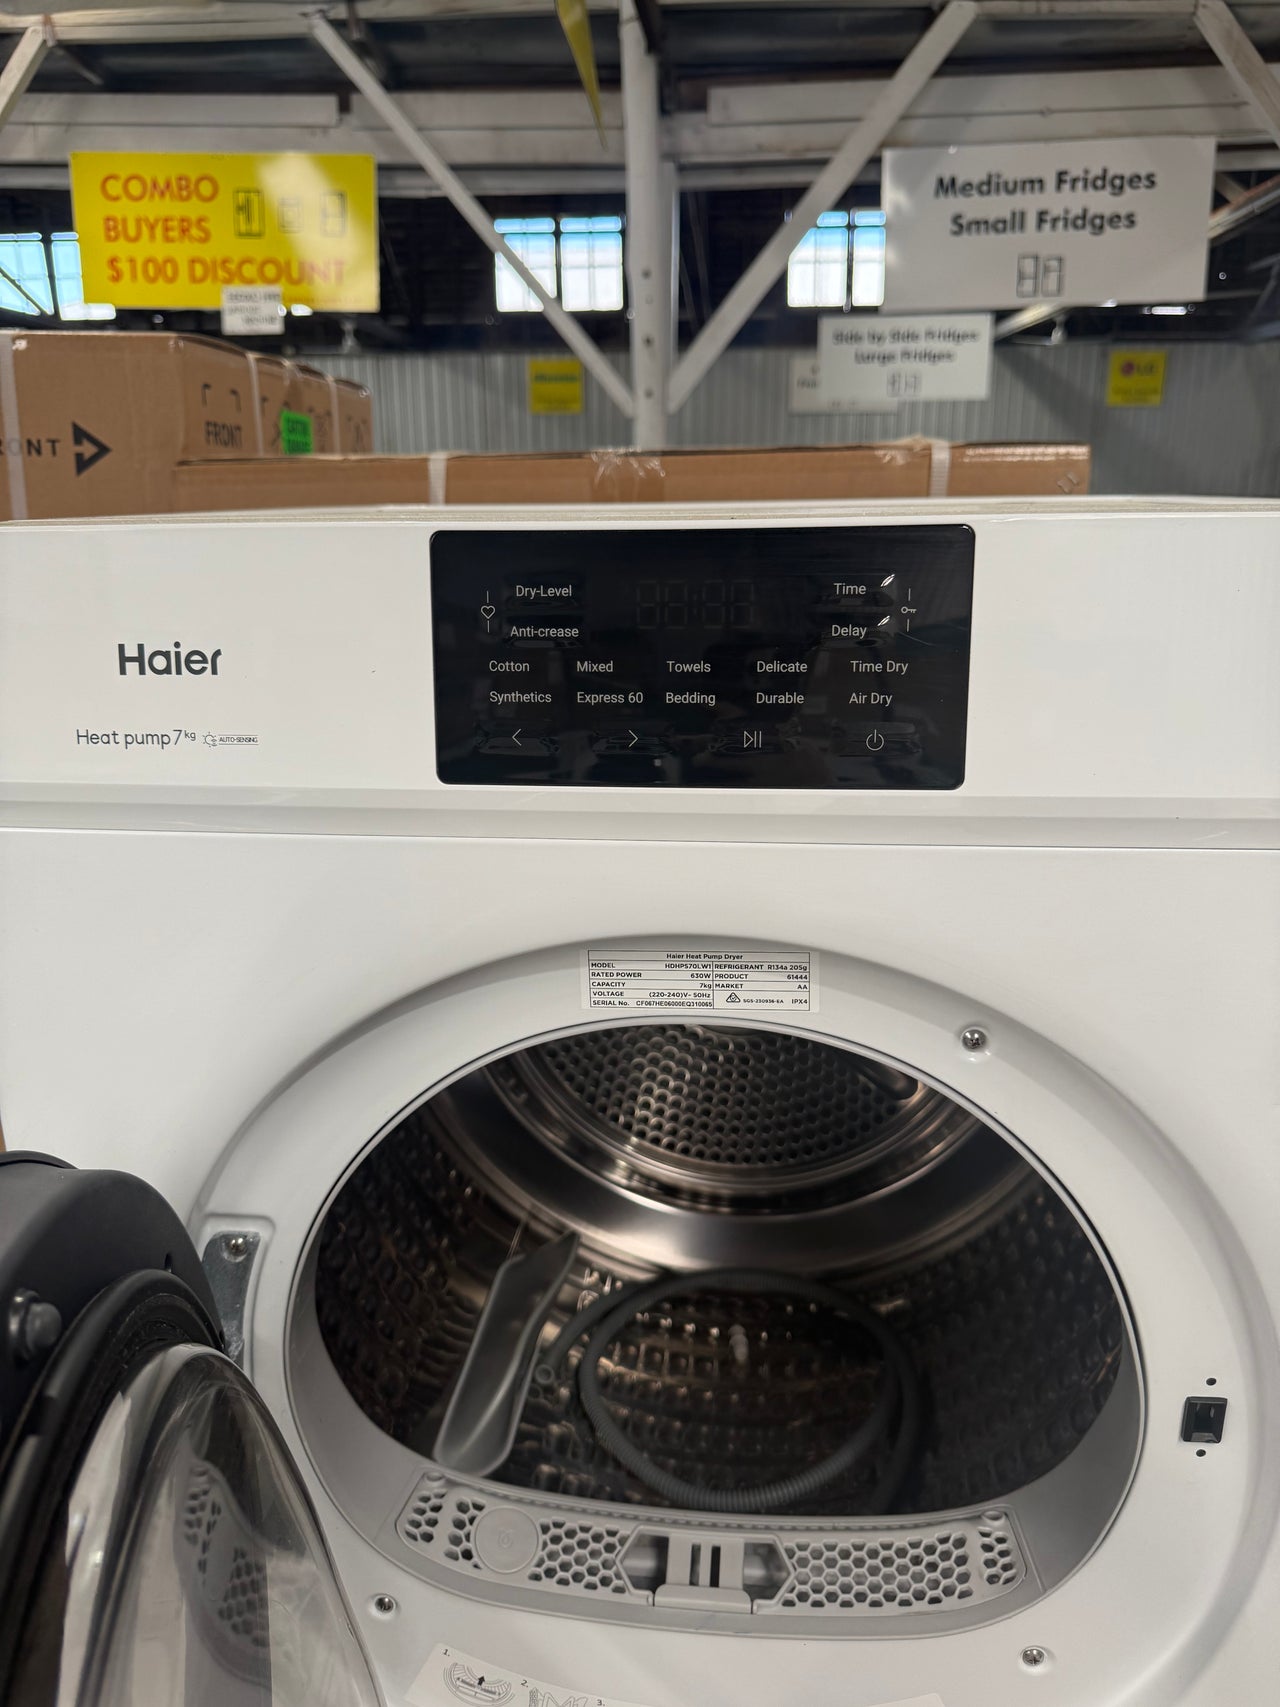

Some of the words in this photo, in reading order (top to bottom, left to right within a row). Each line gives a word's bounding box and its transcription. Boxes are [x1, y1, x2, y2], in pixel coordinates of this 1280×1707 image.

[100, 174, 220, 202] COMBO
[934, 171, 1045, 199] Medium
[1055, 167, 1157, 196] Fridges
[951, 210, 1026, 236] Small
[1036, 206, 1136, 235] Fridges
[103, 215, 211, 243] BUYERS
[107, 256, 179, 284] $100
[188, 256, 345, 285] DISCOUNT
[516, 585, 572, 599] Dry-Level
[834, 582, 867, 595] Time
[510, 626, 579, 638] Anti-crease
[831, 624, 867, 639] Delay
[117, 641, 222, 676] Haier
[489, 660, 530, 673] Cotton
[576, 660, 614, 673] Mixed
[667, 661, 711, 673] Towels
[756, 660, 808, 673] Delicate
[850, 660, 883, 673] Time
[886, 661, 909, 675] Dry
[489, 691, 552, 705] Synthetics
[576, 692, 625, 706] Express
[628, 692, 644, 704] 60
[665, 692, 716, 707] Bedding
[756, 692, 805, 704] Durable
[849, 692, 867, 704] Air
[870, 692, 892, 707] Dry
[76, 729, 119, 745] Heat
[124, 732, 171, 750] pump
[443, 1648, 450, 1657] 1.
[521, 1679, 529, 1688] 2.
[597, 1699, 606, 1707] 3.
